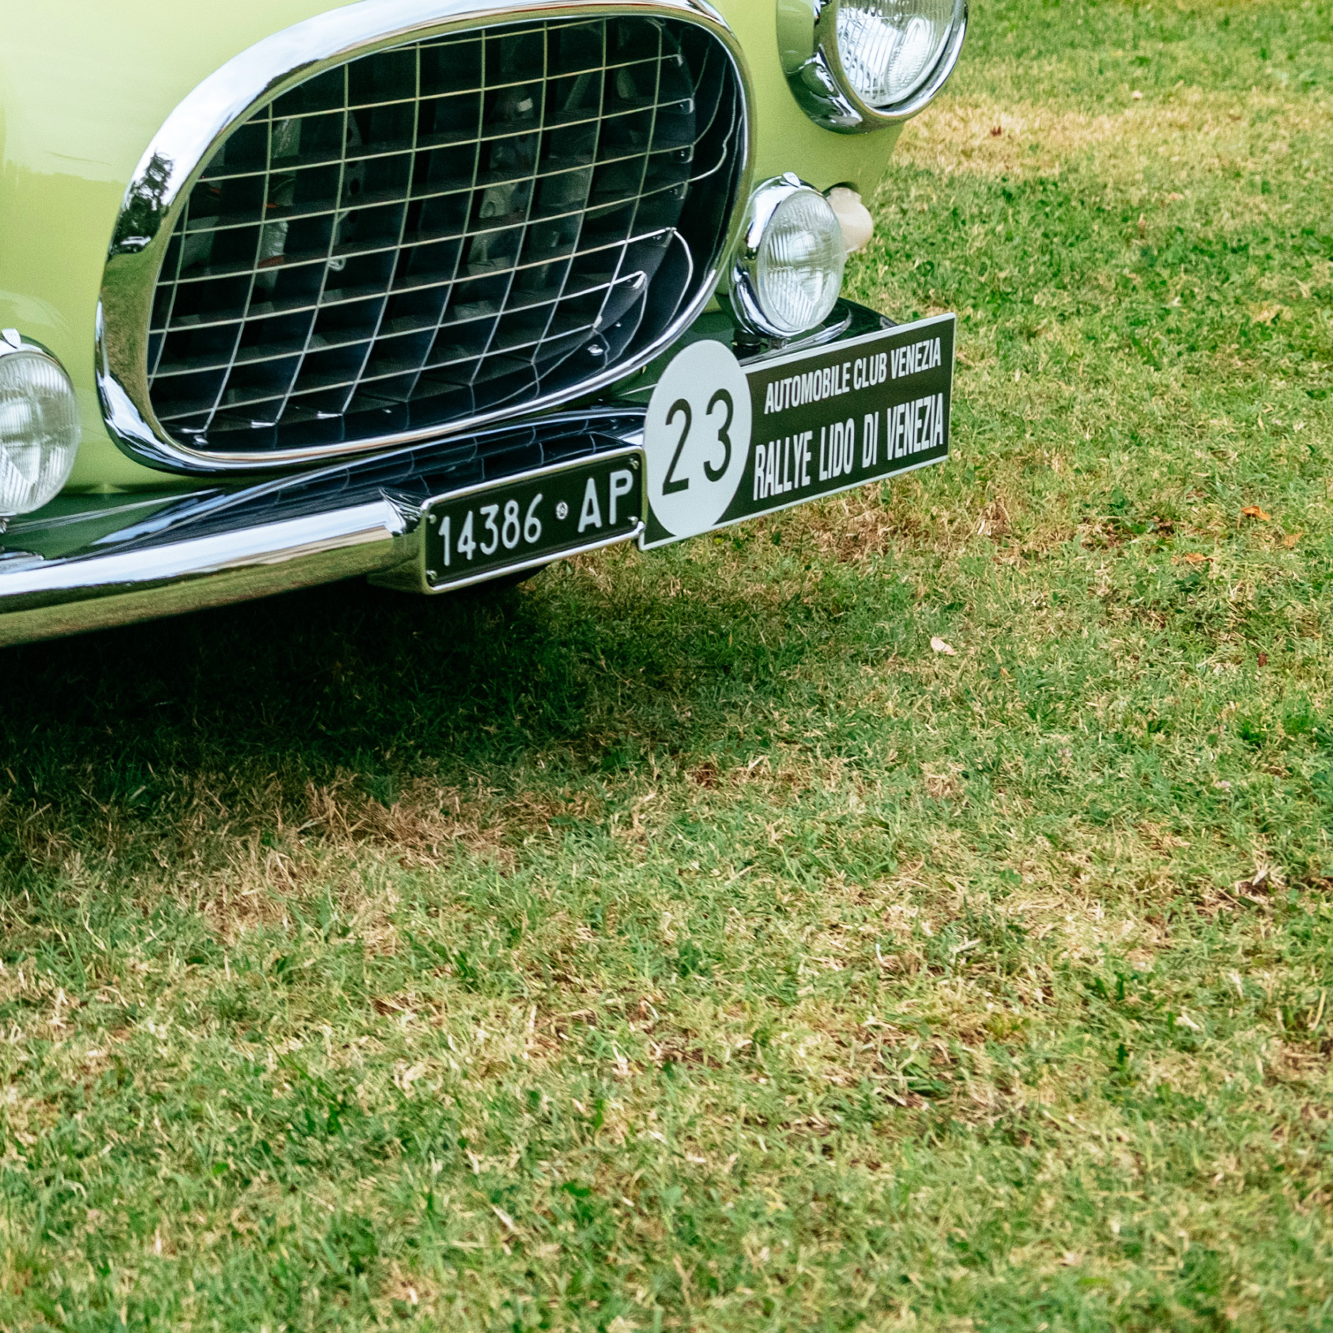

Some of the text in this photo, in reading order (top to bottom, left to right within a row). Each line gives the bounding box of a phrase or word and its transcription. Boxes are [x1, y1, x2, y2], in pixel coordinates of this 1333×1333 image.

[764, 337, 942, 415] AUTOMOBILE CLUB VENEZIA
[662, 388, 734, 496] 23
[753, 392, 944, 501] RALLYE LIDO DI VENEZIA
[438, 469, 634, 567] 14386 AP
